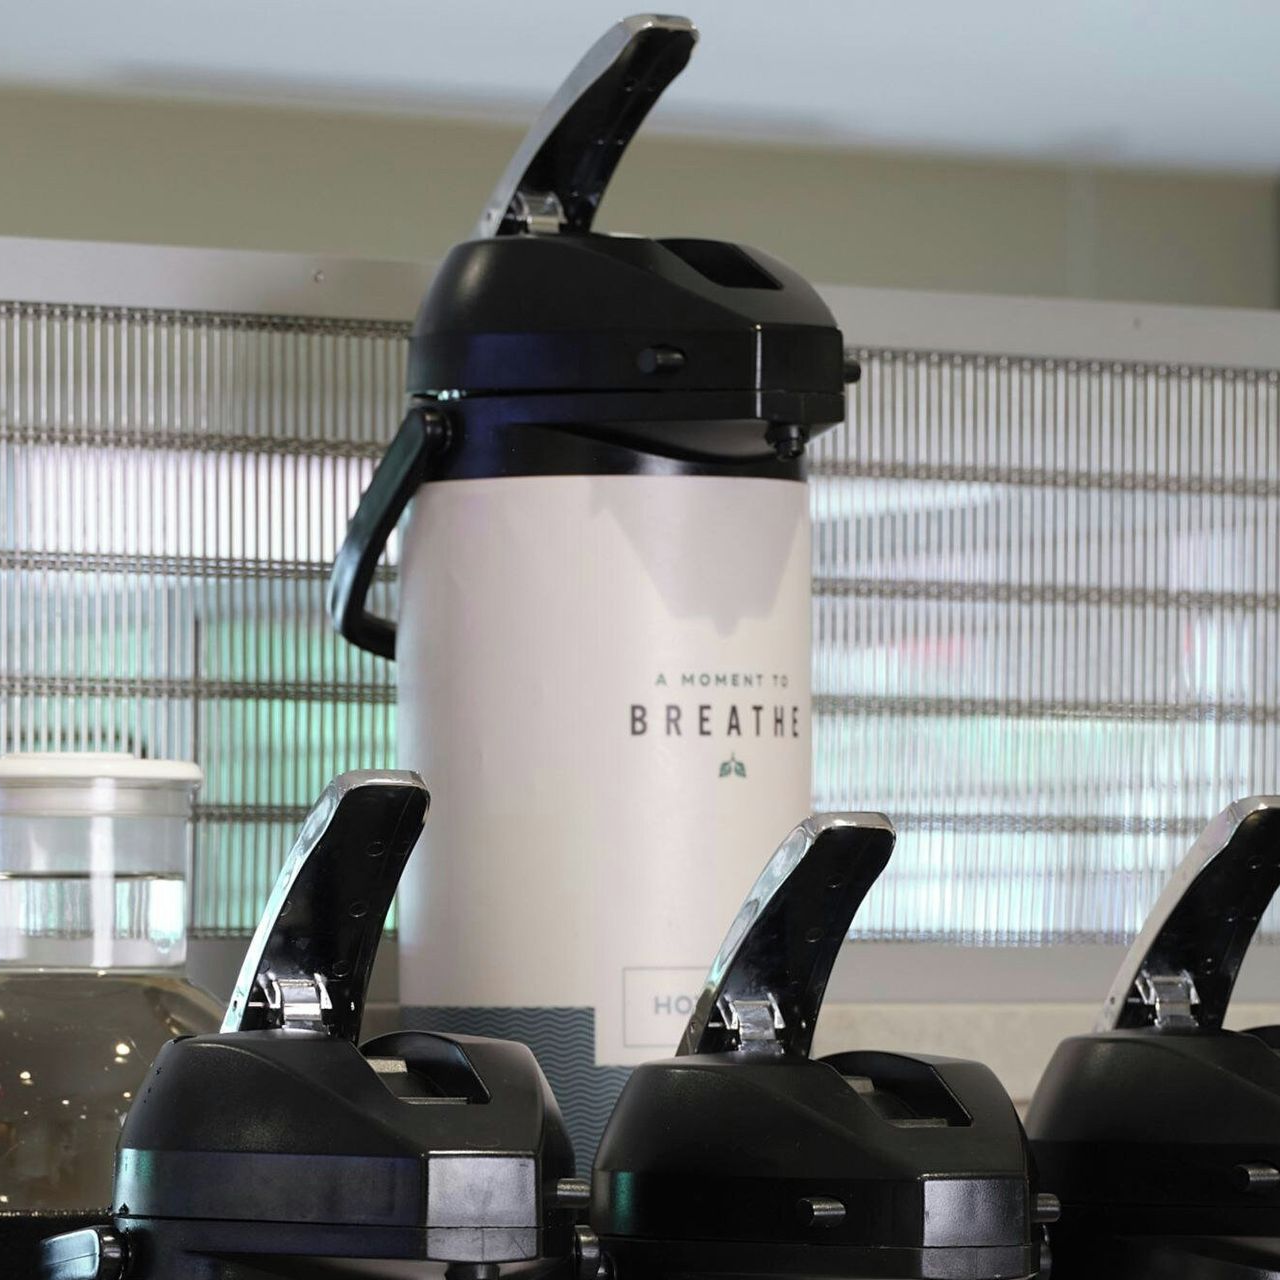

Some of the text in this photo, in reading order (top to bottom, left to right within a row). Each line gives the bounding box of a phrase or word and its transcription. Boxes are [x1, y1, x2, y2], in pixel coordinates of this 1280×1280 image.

[654, 673, 789, 688] A MOMENT TO
[629, 703, 799, 738] BREATHE
[654, 995, 699, 1015] HO
